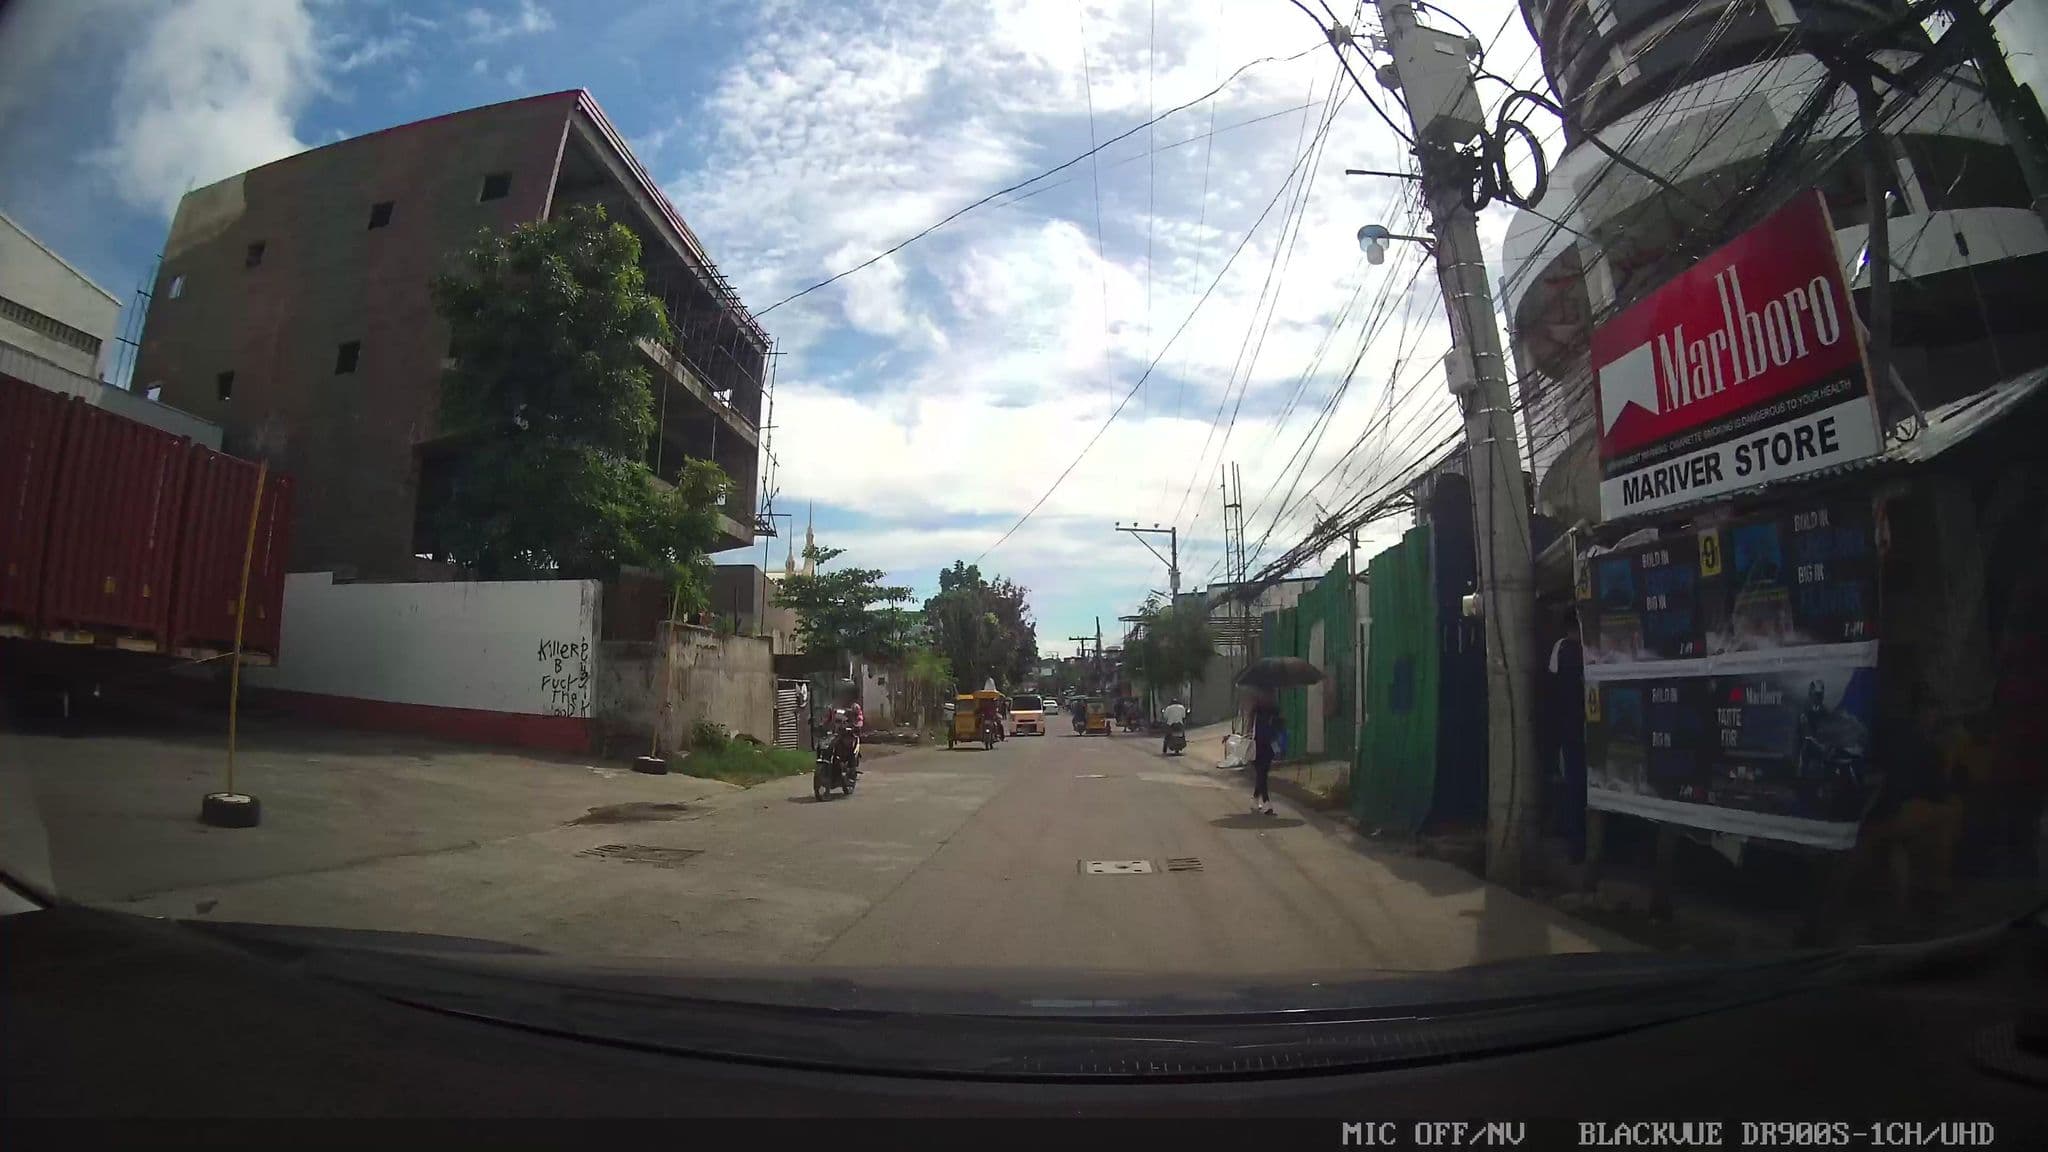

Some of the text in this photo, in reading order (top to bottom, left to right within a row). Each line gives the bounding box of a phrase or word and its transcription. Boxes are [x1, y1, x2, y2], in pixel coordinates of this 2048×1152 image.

[1657, 265, 1840, 415] Marlboro
[1741, 402, 1786, 426] DANGEROUS
[1786, 398, 1797, 413] TO
[1797, 388, 1820, 409] YOUR
[1820, 378, 1852, 399] HEALTH
[1623, 416, 1840, 506] MARIVER STORE
[1797, 562, 1825, 584] BIG IN
[554, 658, 563, 674] B
